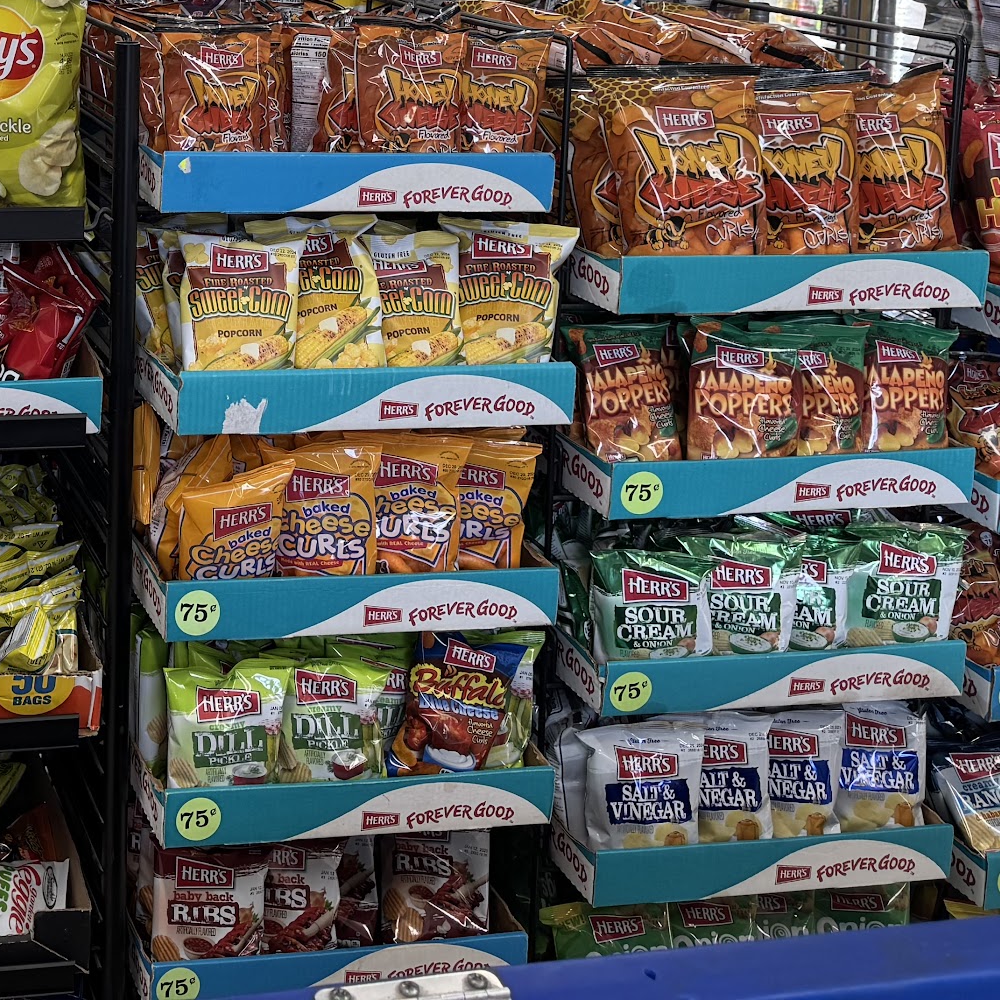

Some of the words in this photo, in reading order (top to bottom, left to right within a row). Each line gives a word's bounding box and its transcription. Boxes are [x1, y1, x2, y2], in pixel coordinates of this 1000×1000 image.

[661, 110, 712, 128] HERR'S
[418, 129, 450, 141] Flavored
[402, 187, 468, 208] FOREVER
[471, 184, 513, 208] GOOD
[705, 221, 758, 245] CURLS
[215, 252, 266, 269] HERR'S
[373, 251, 394, 260] GLUTEN
[395, 250, 410, 258] FREE
[491, 261, 536, 273] ROASTED
[203, 277, 228, 287] FIRE
[230, 276, 273, 287] ROASTED
[849, 284, 911, 304] FOREVER
[912, 281, 950, 302] GOOD
[476, 313, 520, 323] POPCORN
[217, 328, 262, 338] POPCORN
[721, 351, 759, 365] HERR'S
[424, 399, 492, 421] FOREVER
[493, 395, 535, 418] GOOD
[695, 392, 792, 418] POPPERS
[758, 424, 786, 433] Cheese
[625, 483, 660, 502] 75¢
[836, 479, 899, 502] FOREVER
[900, 475, 937, 496] GOOD
[218, 507, 269, 529] HERR'S
[303, 501, 351, 517] baked
[228, 527, 272, 550] baked
[278, 534, 365, 561] CURLS
[628, 577, 682, 598] HERR'S
[180, 602, 217, 622] 75¢
[409, 602, 476, 626] FOREVER
[477, 598, 517, 620] GOOD
[624, 607, 687, 625] SOUR
[617, 624, 695, 642] CREAM
[451, 646, 494, 668] HERR'S
[12, 694, 52, 706] BAGS
[613, 681, 649, 702] 75¢
[419, 696, 448, 711] Blue
[450, 698, 499, 720] Cheese
[194, 732, 264, 757] DILL
[208, 753, 254, 764] PICKLE
[622, 784, 658, 800] SALT
[663, 784, 675, 799] &
[180, 807, 217, 829] 75¢
[610, 800, 686, 823] VINEGAR
[181, 866, 229, 886] HERR'S
[173, 891, 200, 905] baby
[200, 891, 234, 903] back
[171, 904, 237, 923] RIBS
